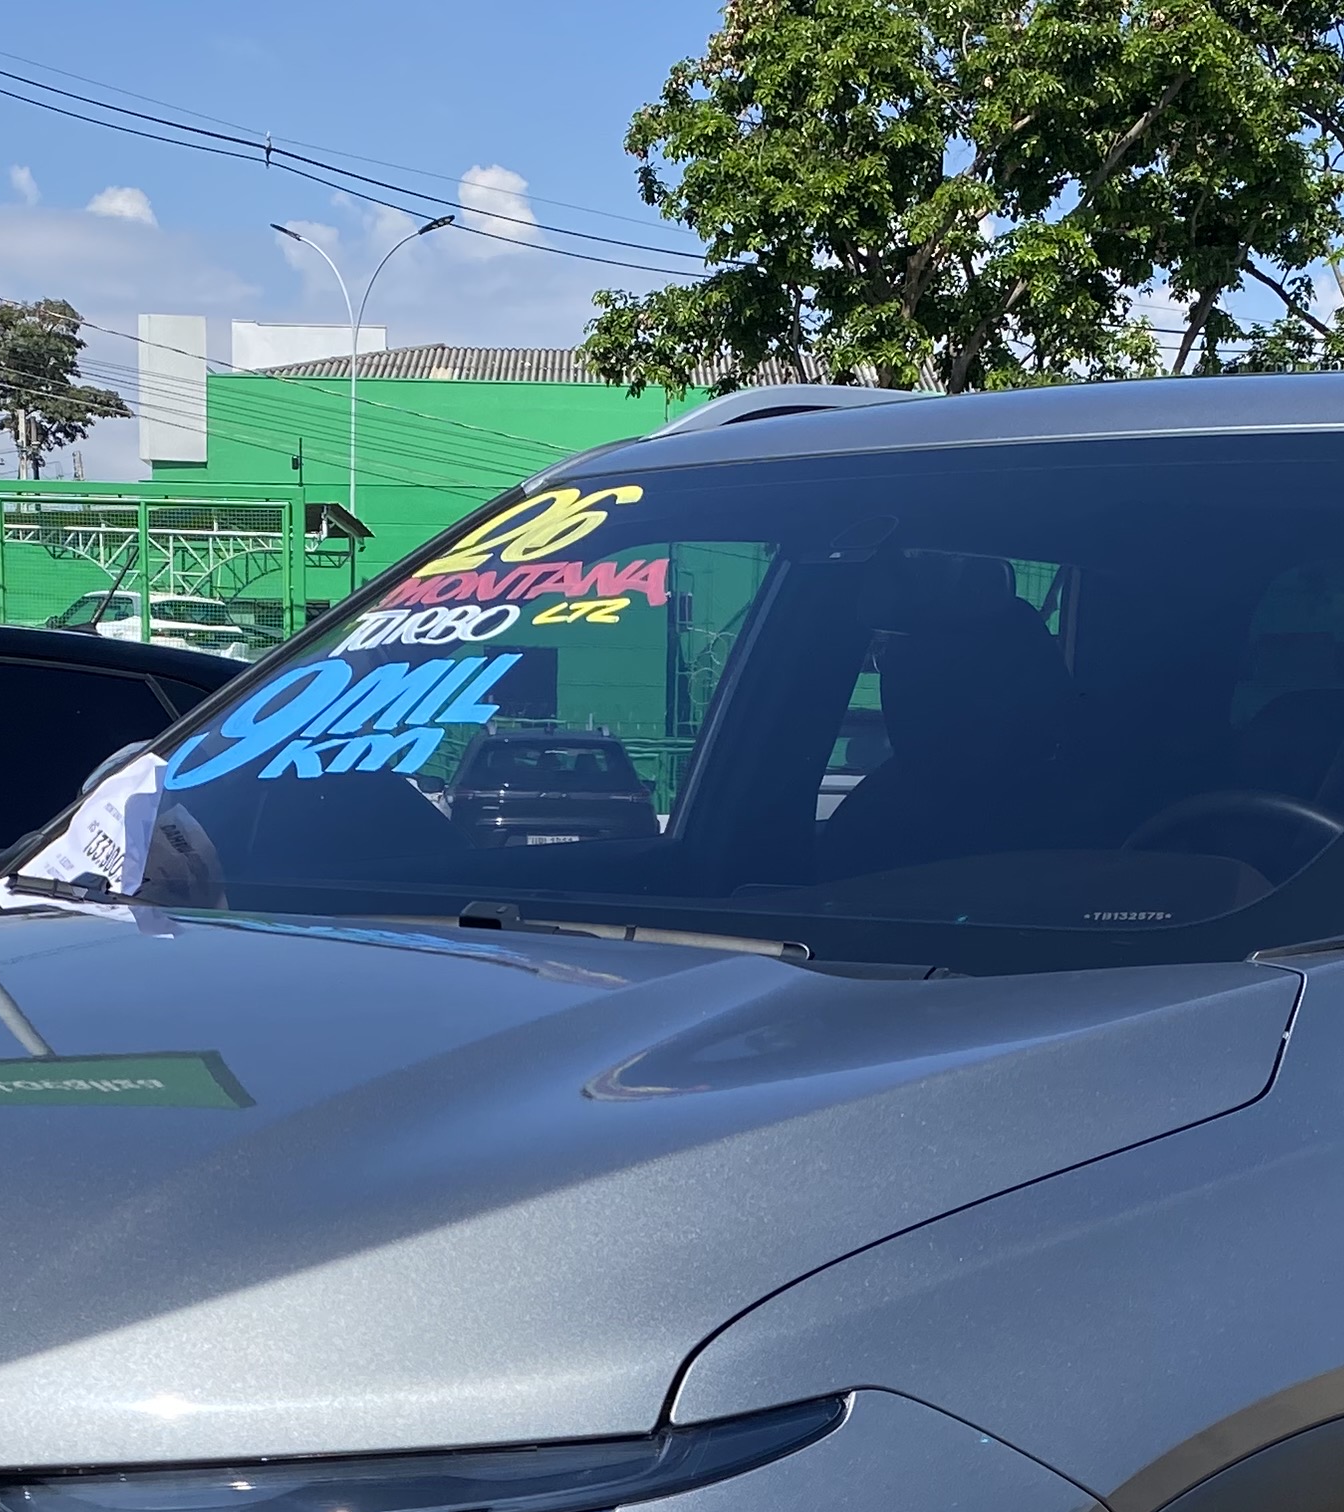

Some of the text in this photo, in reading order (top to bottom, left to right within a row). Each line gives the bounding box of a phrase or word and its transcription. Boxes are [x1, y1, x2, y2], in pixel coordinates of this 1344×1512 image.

[413, 485, 644, 578] 26
[380, 558, 671, 610] MONTANA
[329, 597, 631, 657] TURBO LTZ
[164, 653, 524, 791] 9 MIL
[258, 727, 446, 780] KM
